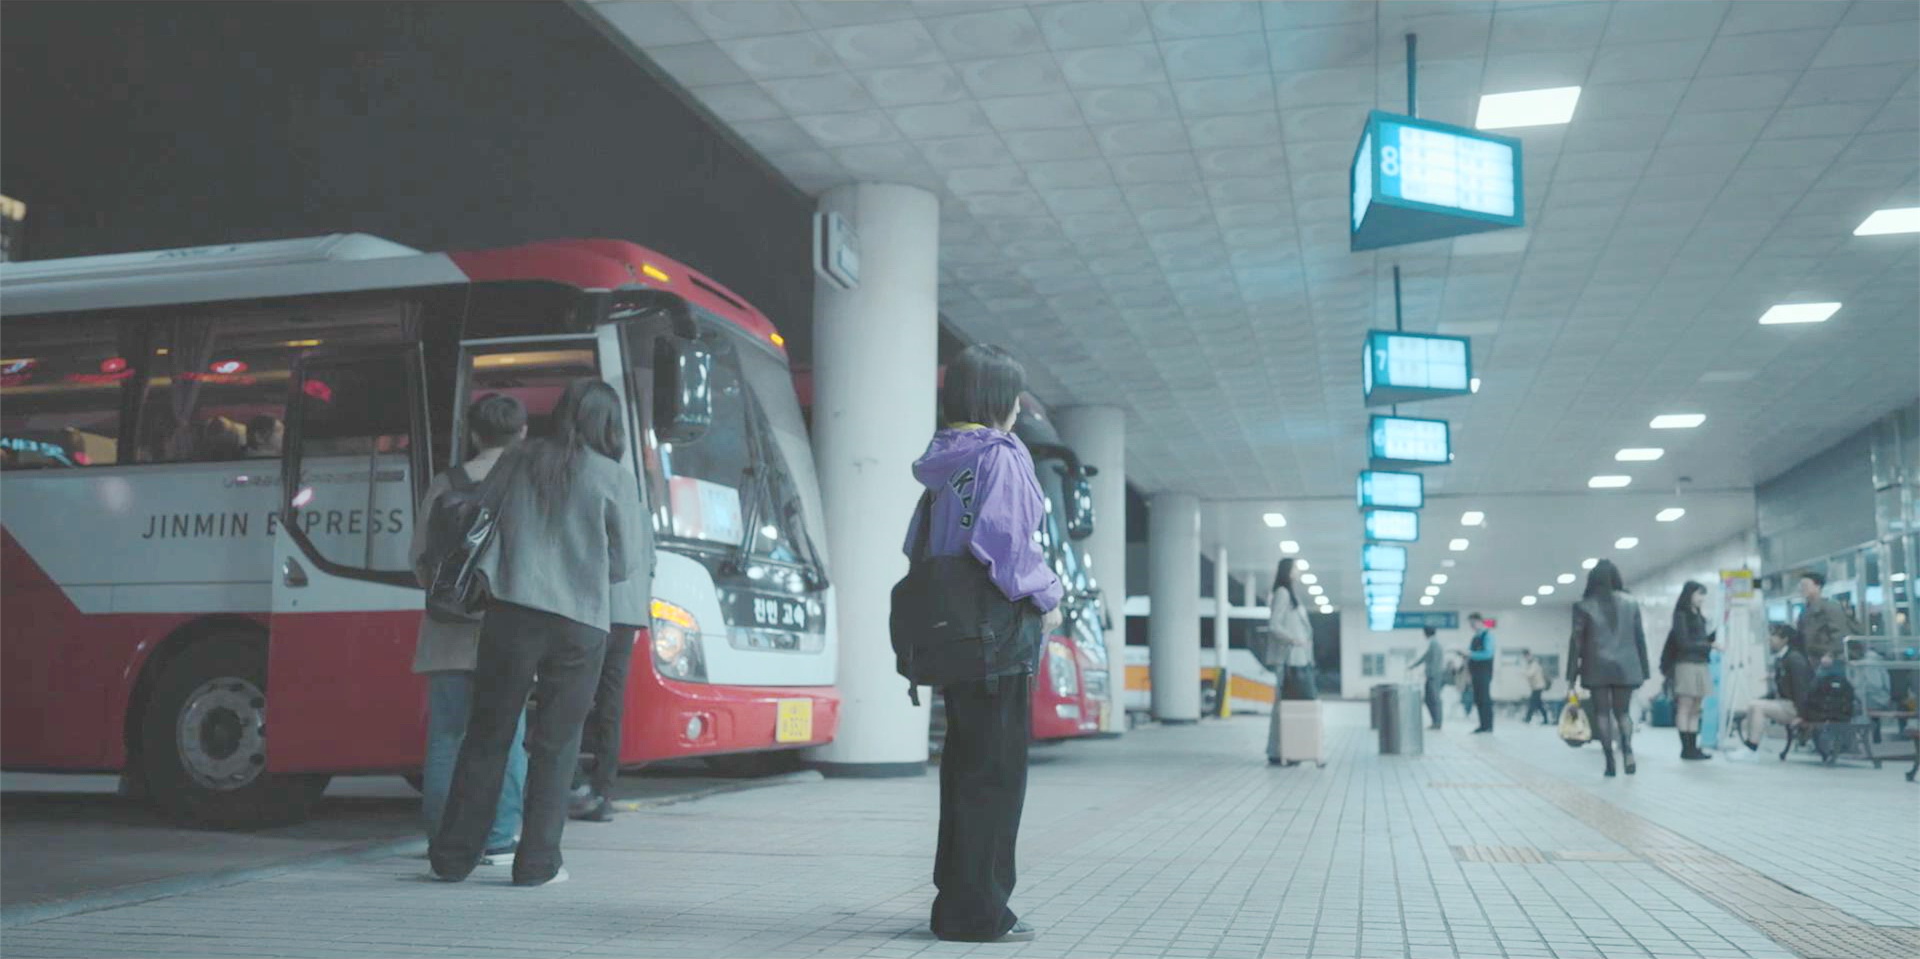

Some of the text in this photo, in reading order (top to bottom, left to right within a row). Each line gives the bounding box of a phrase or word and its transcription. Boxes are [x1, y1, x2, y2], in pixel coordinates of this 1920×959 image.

[1380, 145, 1400, 176] 8
[1375, 349, 1386, 371] 7
[142, 508, 404, 539] JINMIN EPRESS
